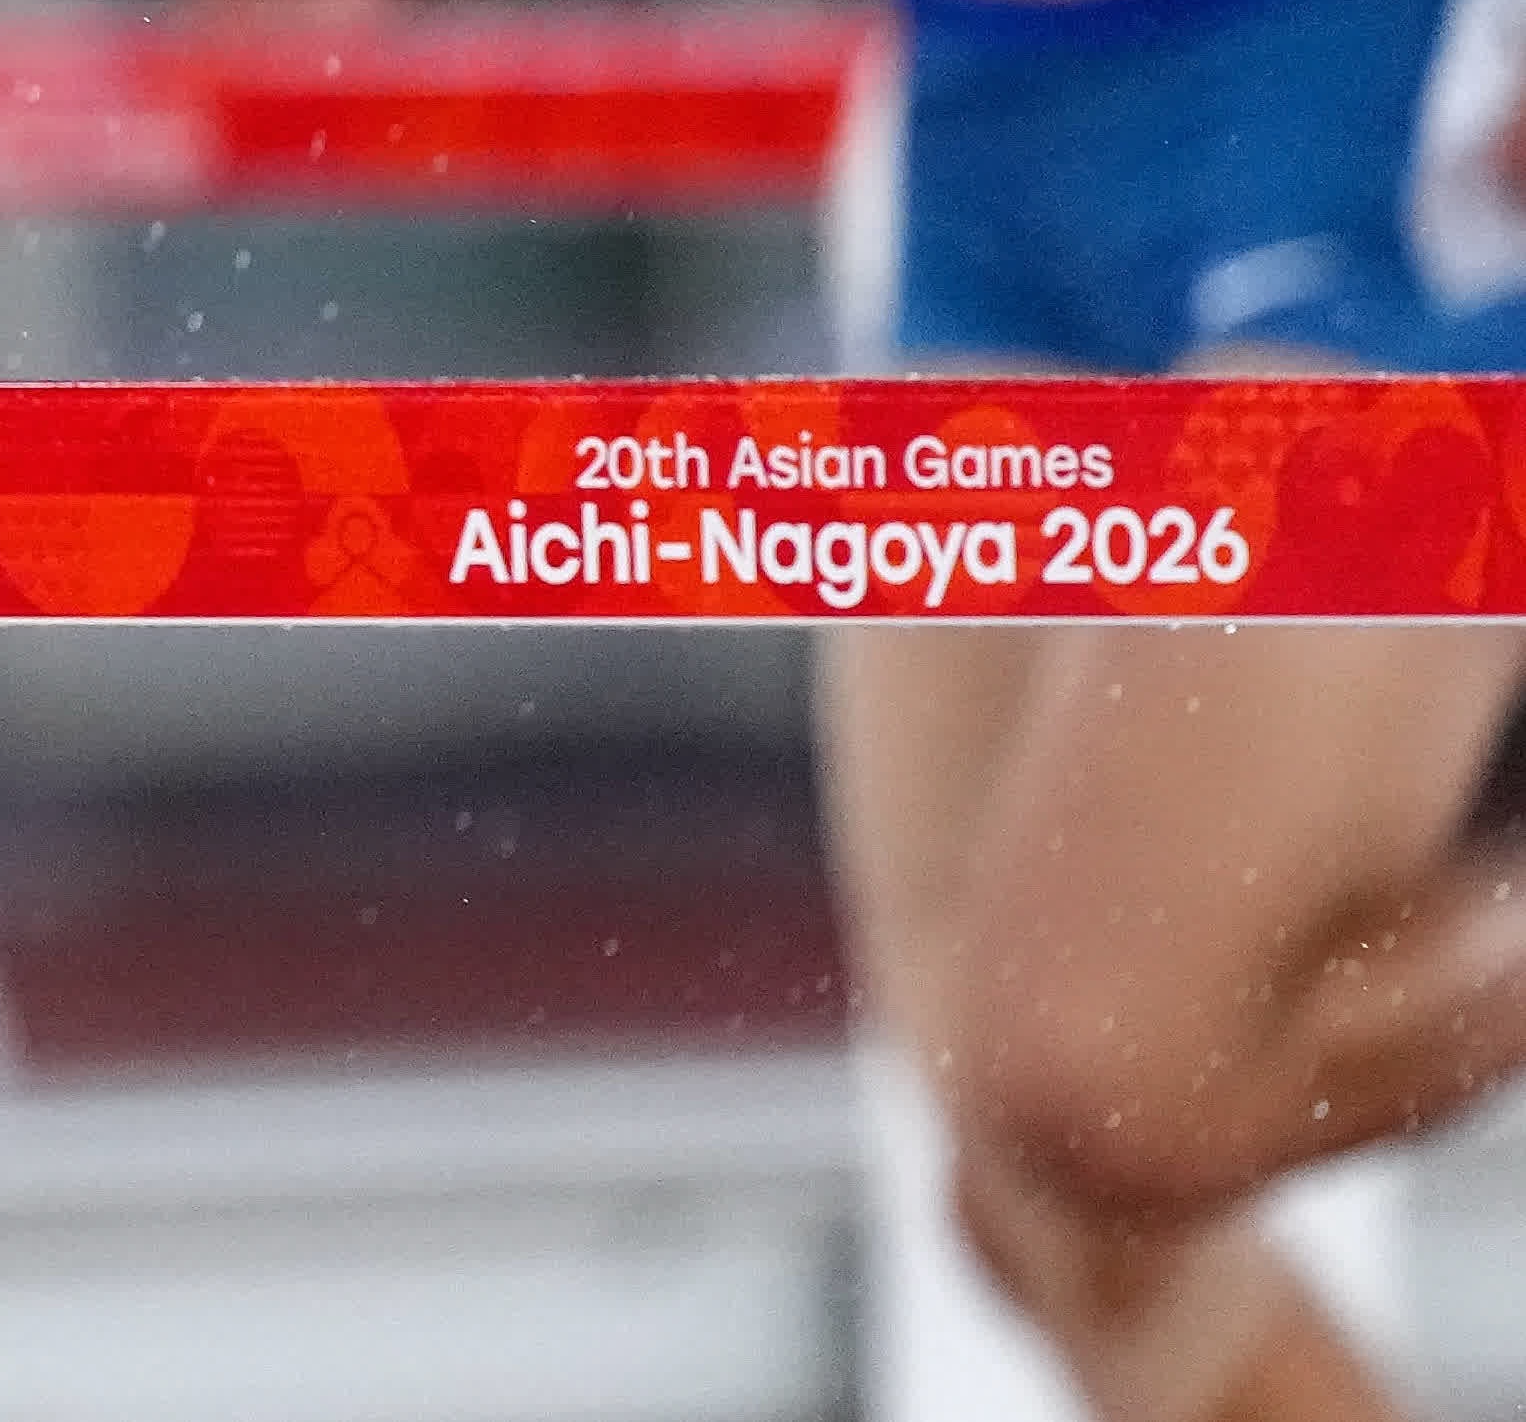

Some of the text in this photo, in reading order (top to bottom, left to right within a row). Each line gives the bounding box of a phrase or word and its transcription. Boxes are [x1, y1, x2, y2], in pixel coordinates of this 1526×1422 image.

[575, 431, 1113, 489] 20th Asian Games
[449, 500, 1249, 609] Aichi-Nagoya 2026
